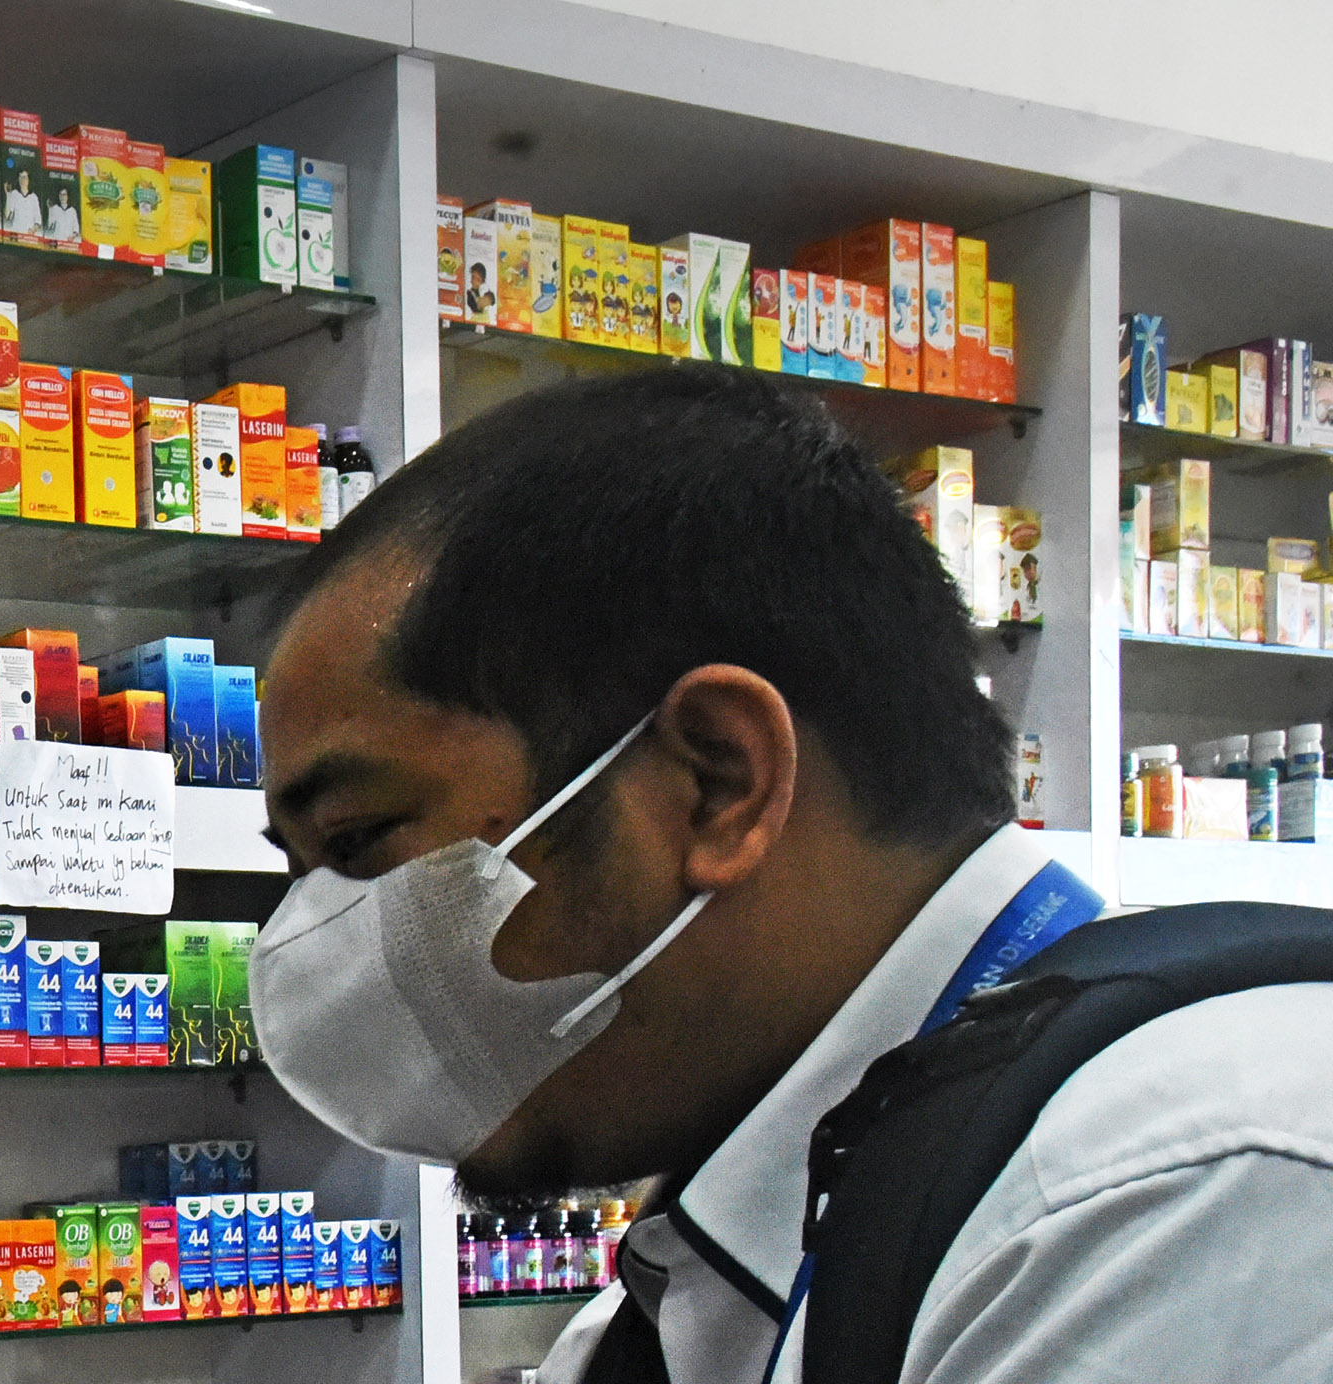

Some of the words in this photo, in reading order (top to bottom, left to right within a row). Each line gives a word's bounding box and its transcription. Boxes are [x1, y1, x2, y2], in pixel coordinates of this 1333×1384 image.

[242, 418, 284, 438] LASERIN
[288, 451, 318, 465] LASERIN
[2, 813, 44, 841] Tidak
[38, 974, 61, 992] 44
[74, 975, 97, 992] 44
[114, 1004, 132, 1019] 44
[64, 1225, 90, 1242] OB
[108, 1225, 133, 1242] OB
